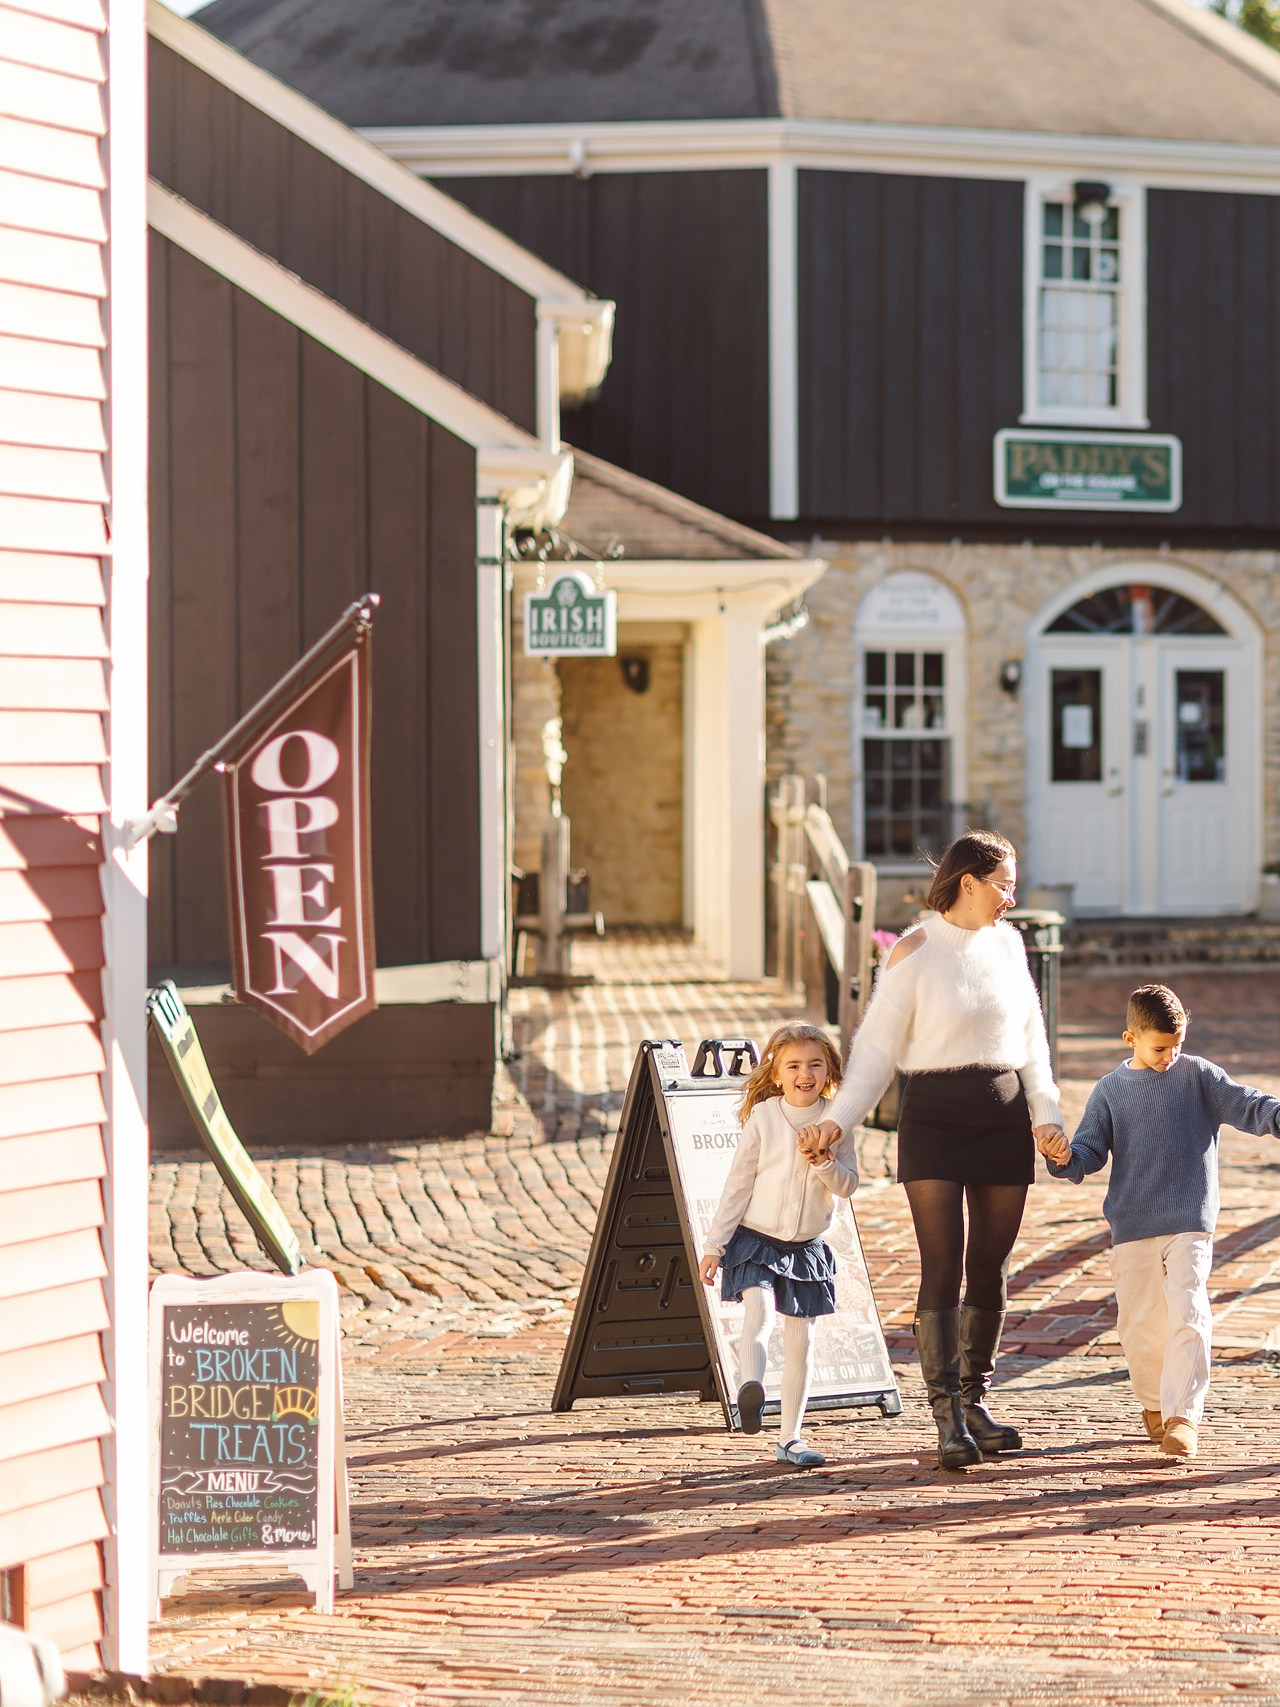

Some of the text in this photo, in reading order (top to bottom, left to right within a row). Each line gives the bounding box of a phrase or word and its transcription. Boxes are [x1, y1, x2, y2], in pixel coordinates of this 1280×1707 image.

[1008, 442, 1168, 488] PADDY'S
[531, 607, 603, 633] IRISH
[531, 633, 602, 648] BOUTIQUE
[252, 730, 348, 999] OPEN
[169, 1320, 249, 1346] Welcome
[166, 1346, 298, 1383] to BROKEN
[812, 1363, 877, 1382] OME ON IN!
[168, 1384, 271, 1421] BRIDGE
[189, 1422, 306, 1464] TREATS
[207, 1472, 259, 1492] MENU
[167, 1496, 202, 1510] Donuts
[205, 1495, 224, 1509] Pies
[225, 1495, 261, 1509] Chocolate
[167, 1510, 284, 1525] Truffles Apple Cider Candy
[167, 1527, 184, 1544] Hot
[186, 1526, 229, 1543] Chocolate
[230, 1526, 259, 1543] Gifts
